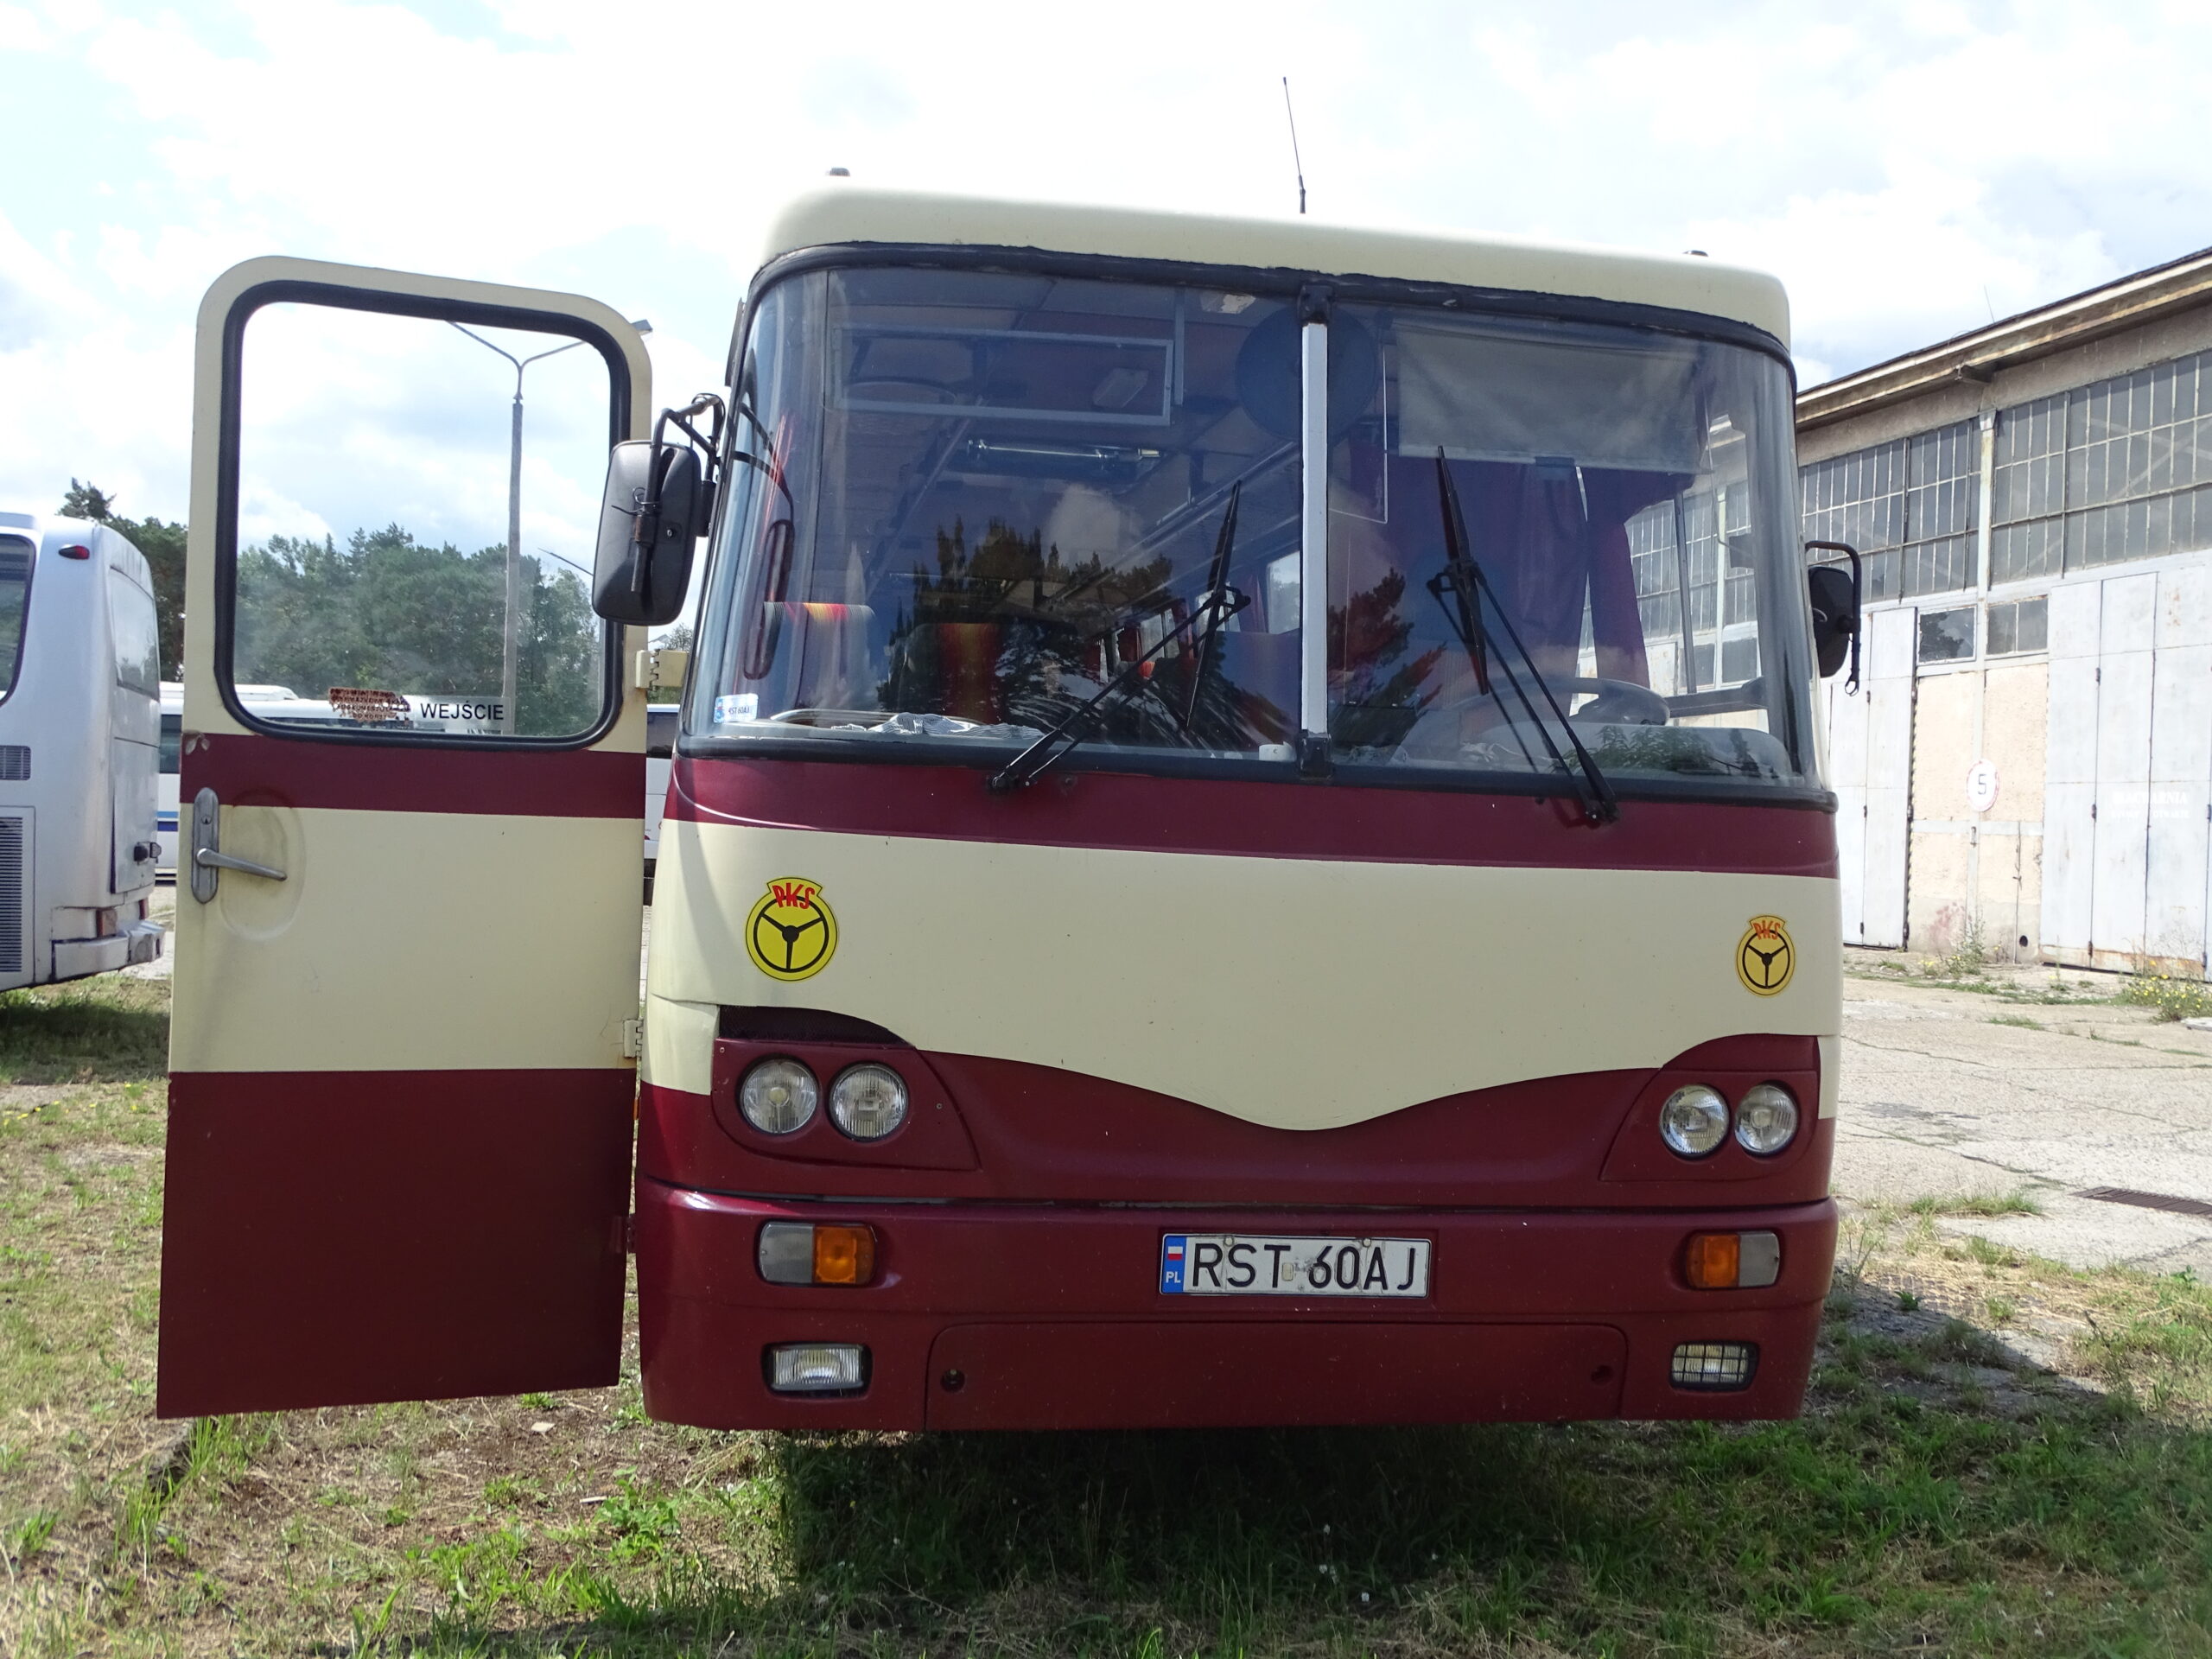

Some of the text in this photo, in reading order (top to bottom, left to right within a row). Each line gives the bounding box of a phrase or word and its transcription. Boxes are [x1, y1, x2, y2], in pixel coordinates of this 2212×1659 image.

[420, 700, 504, 720] WEJŚCIE
[1977, 773, 1987, 795] 5
[772, 882, 816, 910] PKS
[1752, 918, 1782, 941] PKS
[1166, 1271, 1181, 1284] PL
[1192, 1243, 1416, 1291] RST 60AJ
